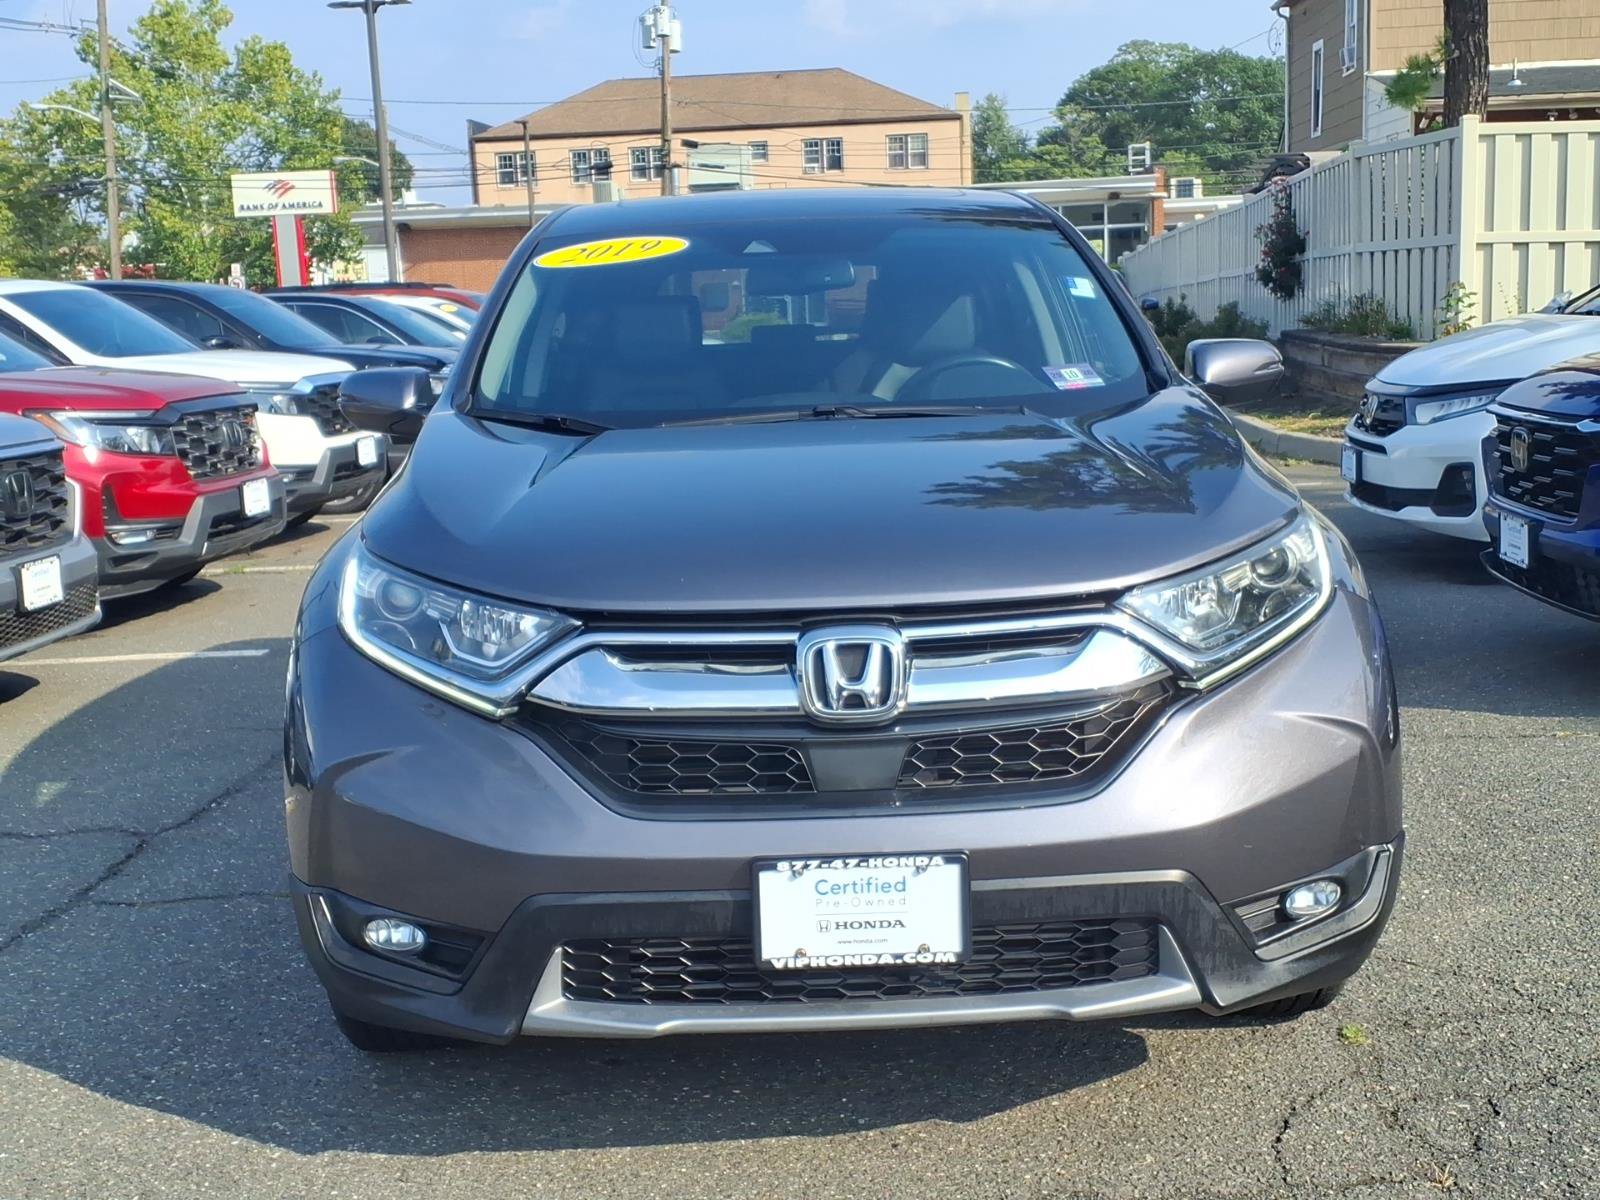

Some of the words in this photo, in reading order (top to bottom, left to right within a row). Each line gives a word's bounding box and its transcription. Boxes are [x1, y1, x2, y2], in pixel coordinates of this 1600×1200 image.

[239, 203, 265, 212] BANK
[281, 201, 323, 209] AMERICA
[560, 239, 662, 263] 2019
[776, 855, 946, 872] 877-47-HONDA
[814, 875, 907, 896] Certified
[815, 896, 907, 908] Pre-Owned
[834, 919, 907, 930] HONDA
[837, 937, 889, 945] www.honda.com
[769, 951, 957, 969] VIPHONDA.COM
